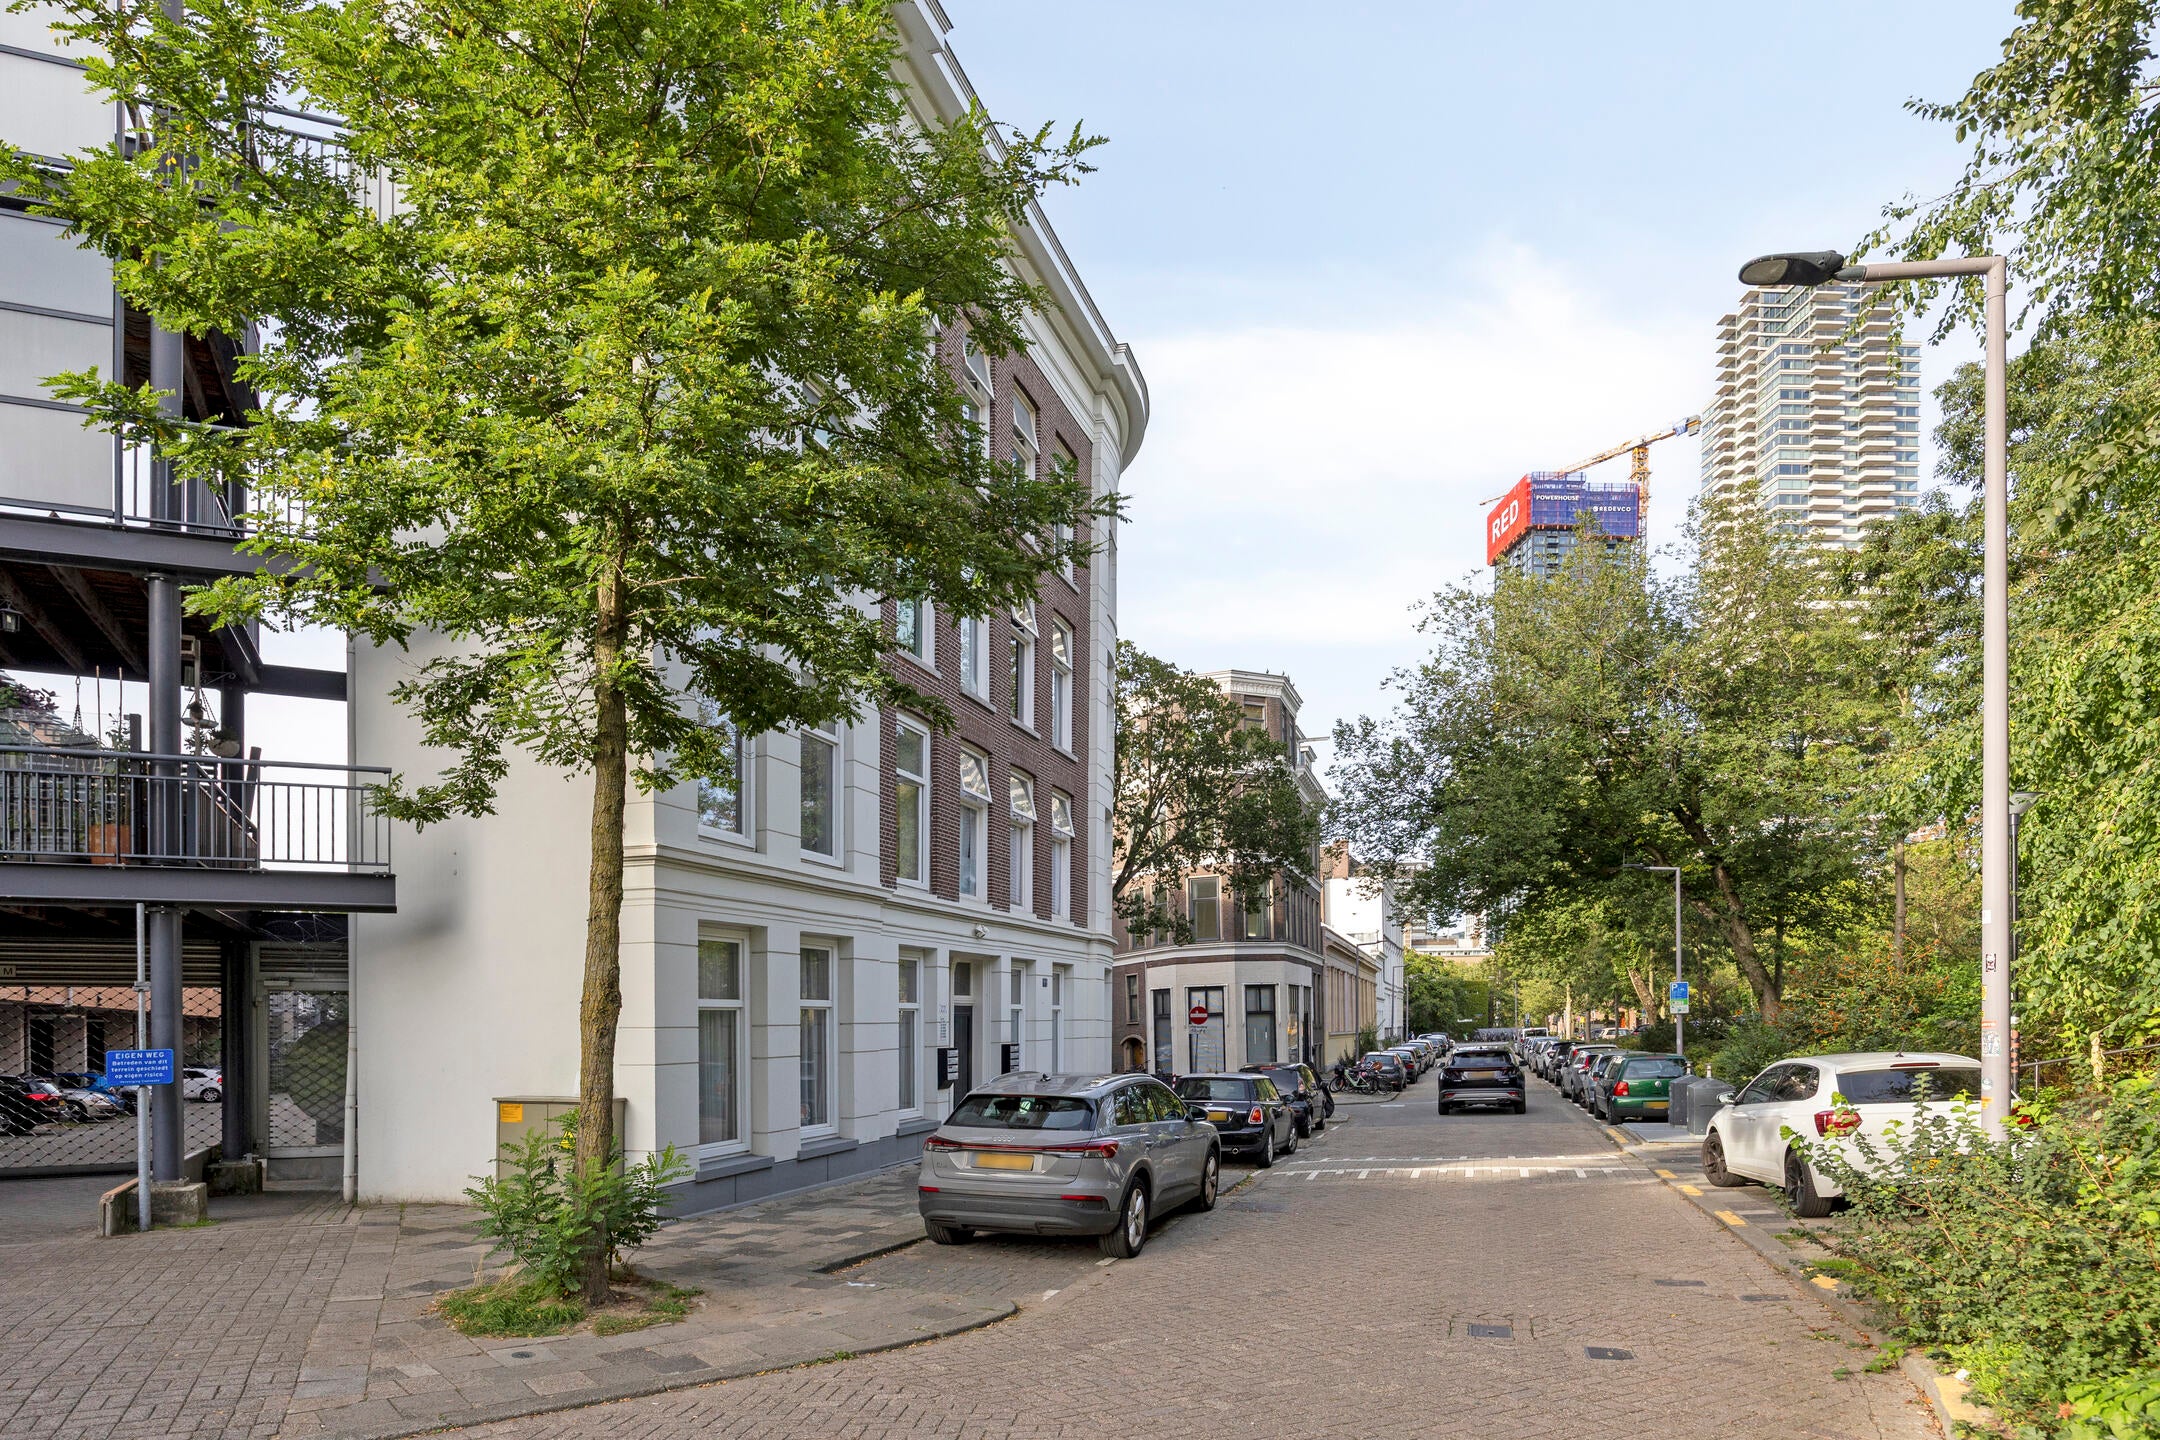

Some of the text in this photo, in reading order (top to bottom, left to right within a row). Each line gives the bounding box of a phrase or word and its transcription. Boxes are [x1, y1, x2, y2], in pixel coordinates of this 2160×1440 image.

[1491, 499, 1519, 544] RED
[1671, 983, 1678, 992] P
[115, 1051, 165, 1060] EIGEN WEG
[136, 1065, 169, 1073] geschiedt
